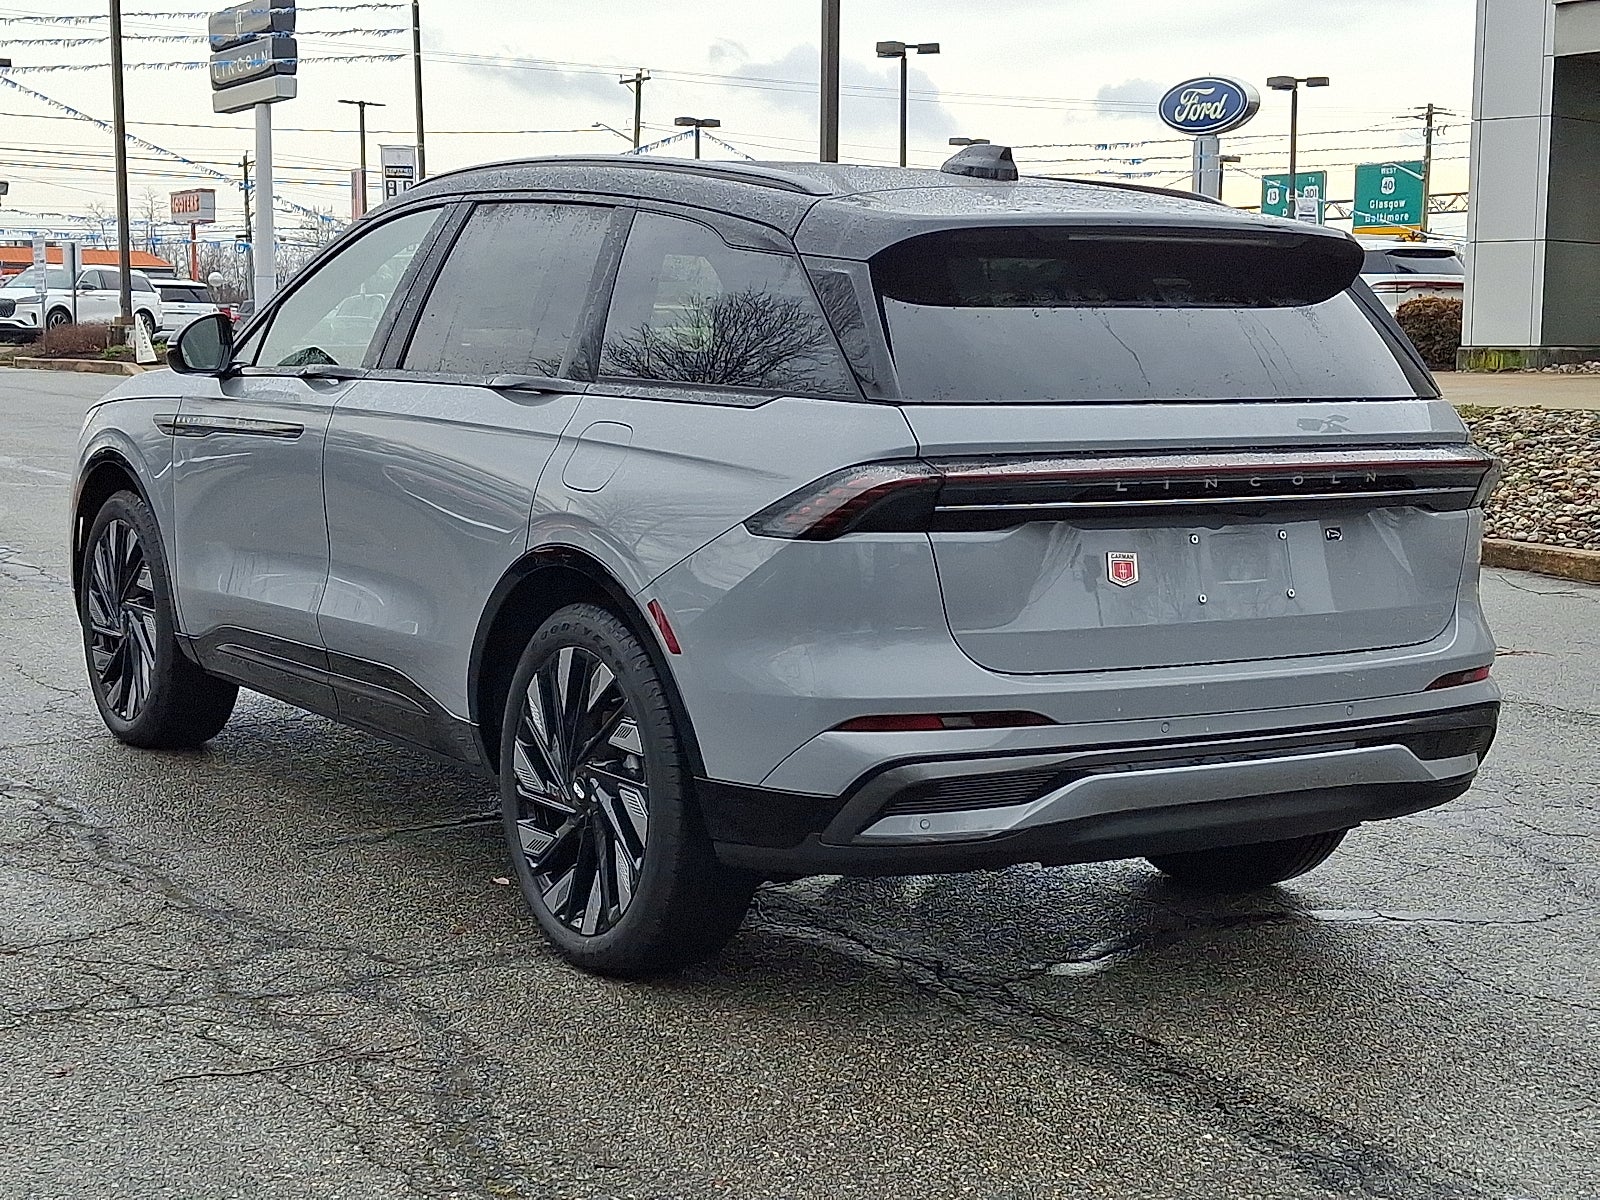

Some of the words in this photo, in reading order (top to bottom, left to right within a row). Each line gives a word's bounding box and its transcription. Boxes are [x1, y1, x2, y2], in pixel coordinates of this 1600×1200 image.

[214, 49, 268, 79] LINCOLN
[1174, 87, 1229, 123] Ford
[1382, 180, 1394, 191] 40
[1269, 191, 1277, 201] 13
[1304, 188, 1317, 198] 301
[1369, 199, 1406, 211] Glasgow
[1365, 212, 1410, 223] Baltimore
[1115, 472, 1378, 492] LINCOLN
